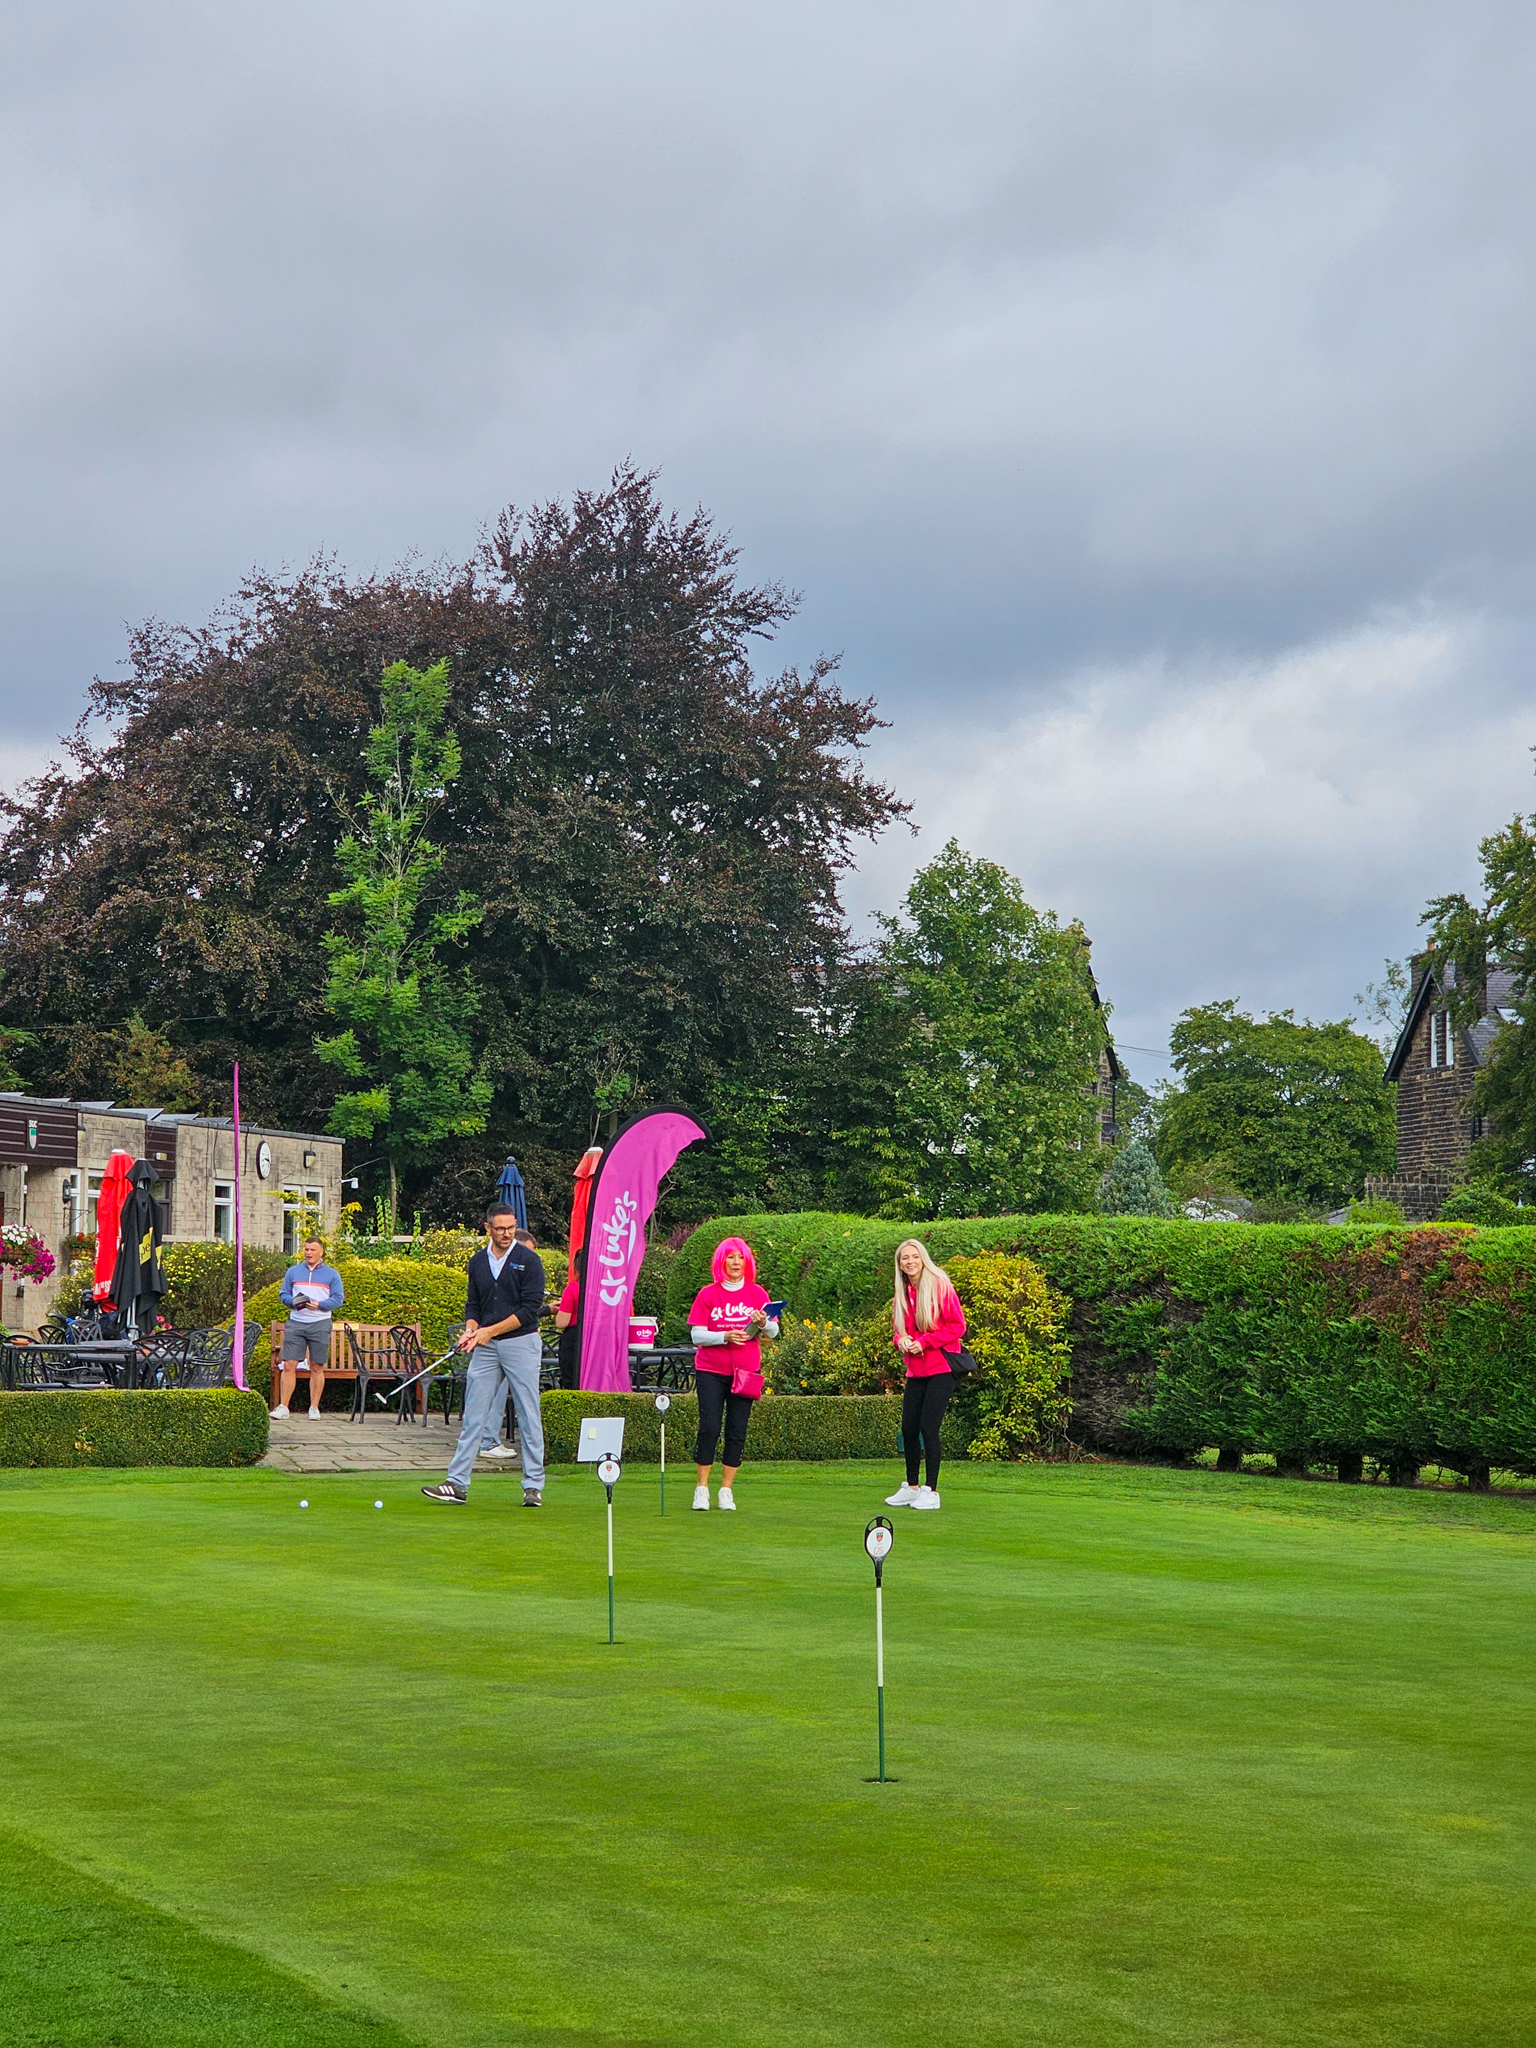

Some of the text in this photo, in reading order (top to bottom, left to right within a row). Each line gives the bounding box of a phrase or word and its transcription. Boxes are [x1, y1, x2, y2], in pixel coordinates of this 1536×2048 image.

[599, 1190, 637, 1306] St Luke's
[711, 1306, 724, 1321] St
